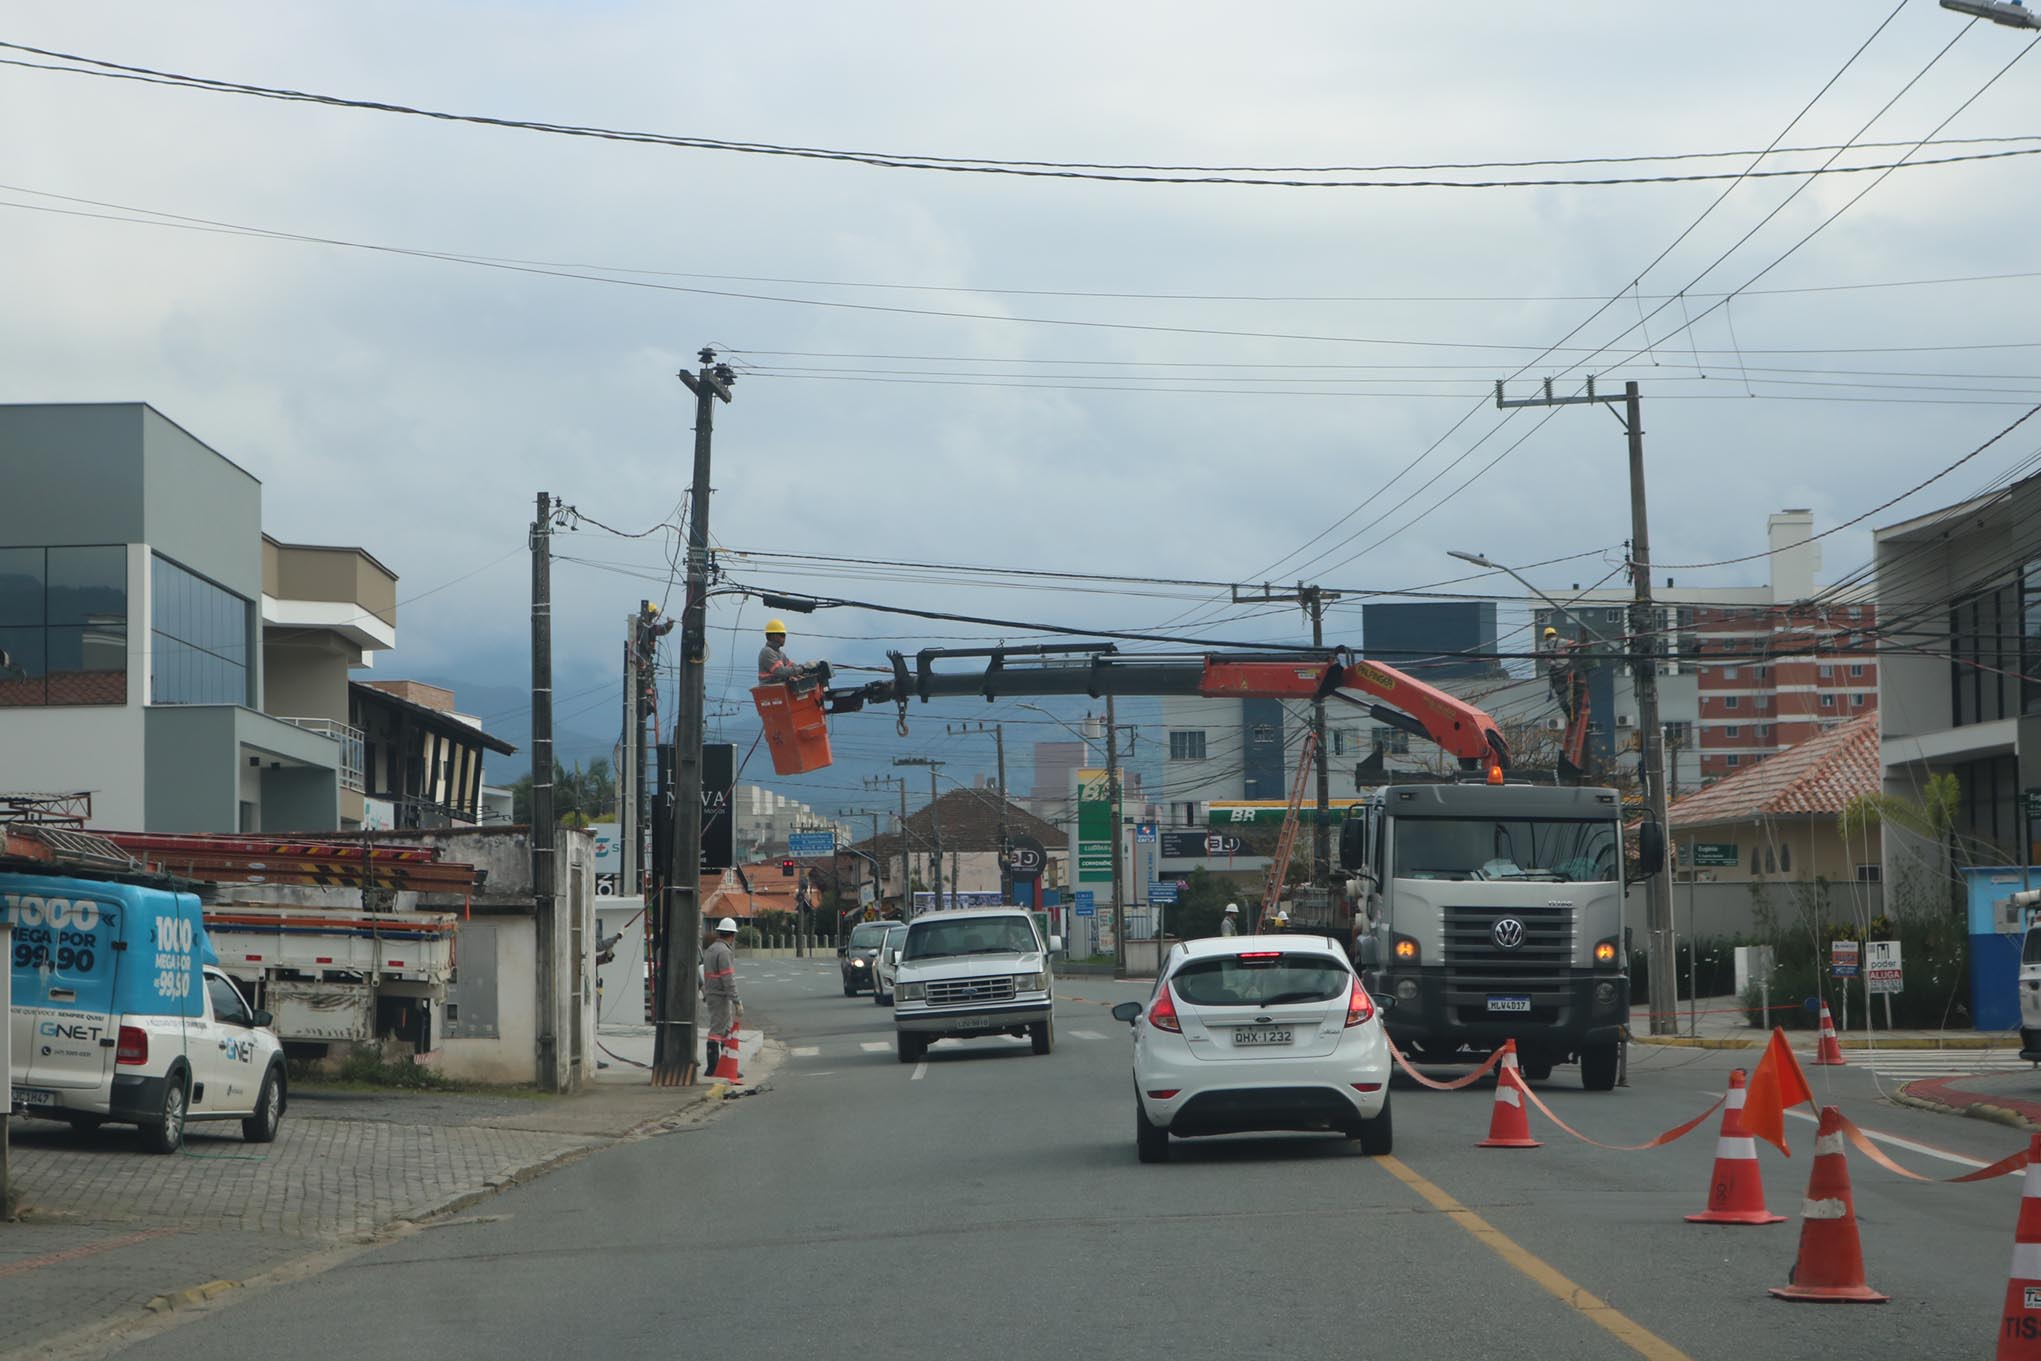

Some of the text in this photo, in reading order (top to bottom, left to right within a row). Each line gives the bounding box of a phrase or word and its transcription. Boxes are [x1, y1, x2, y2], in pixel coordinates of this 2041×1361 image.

[1230, 809, 1256, 822] BR
[4, 895, 99, 931] 1000
[59, 931, 96, 948] POR
[156, 916, 192, 954] 1000
[155, 954, 176, 969] MEGA
[1871, 960, 1896, 969] poder
[1870, 970, 1900, 979] ALUGA
[40, 1022, 102, 1040] GNET
